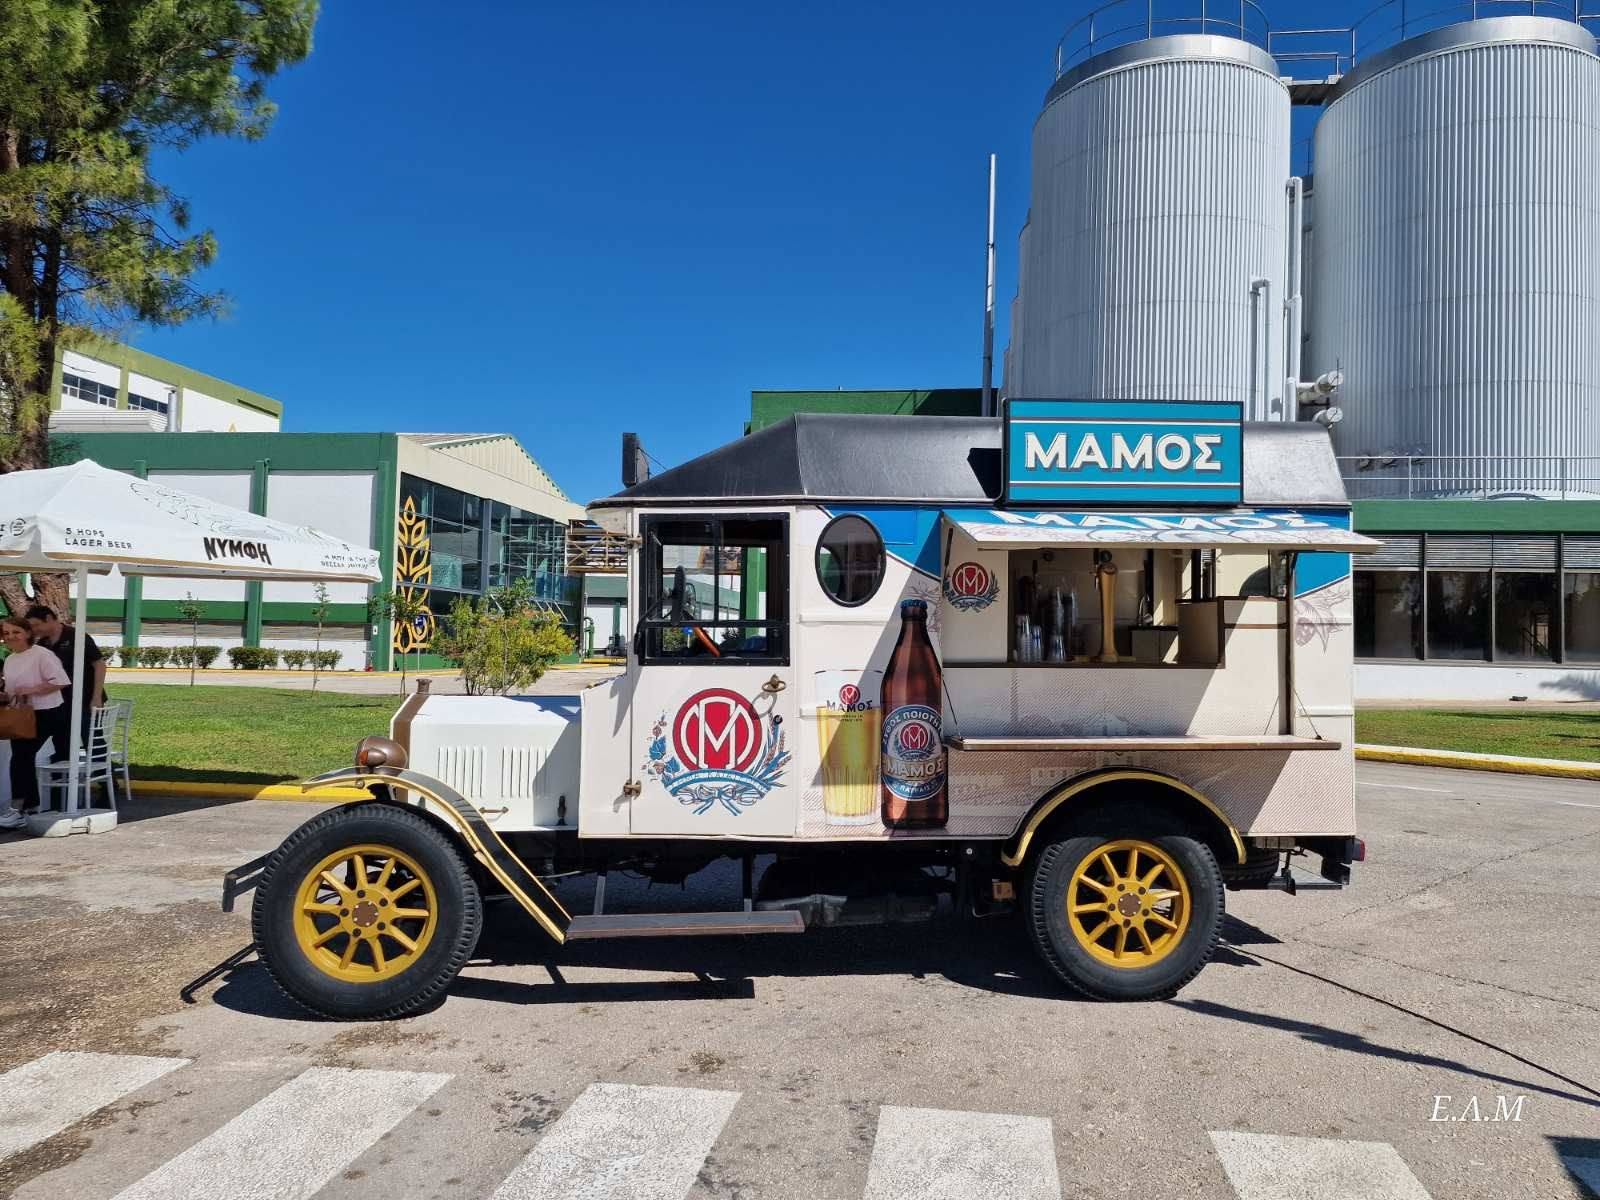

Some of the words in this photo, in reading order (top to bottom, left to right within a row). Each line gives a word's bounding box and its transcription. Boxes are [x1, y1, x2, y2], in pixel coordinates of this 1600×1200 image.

[1024, 431, 1223, 472] ΜΑΜΟΣ
[989, 510, 1329, 530] ΜΑΜΟΣ
[65, 527, 72, 535] 5
[77, 528, 105, 538] HOPS
[64, 538, 103, 547] LAGER
[107, 540, 132, 549] BEER
[203, 537, 272, 566] ΝΥΜΦΗ
[826, 699, 873, 713] ΜΑΜΟΣ
[887, 758, 944, 778] ΜΑΜΟΣ
